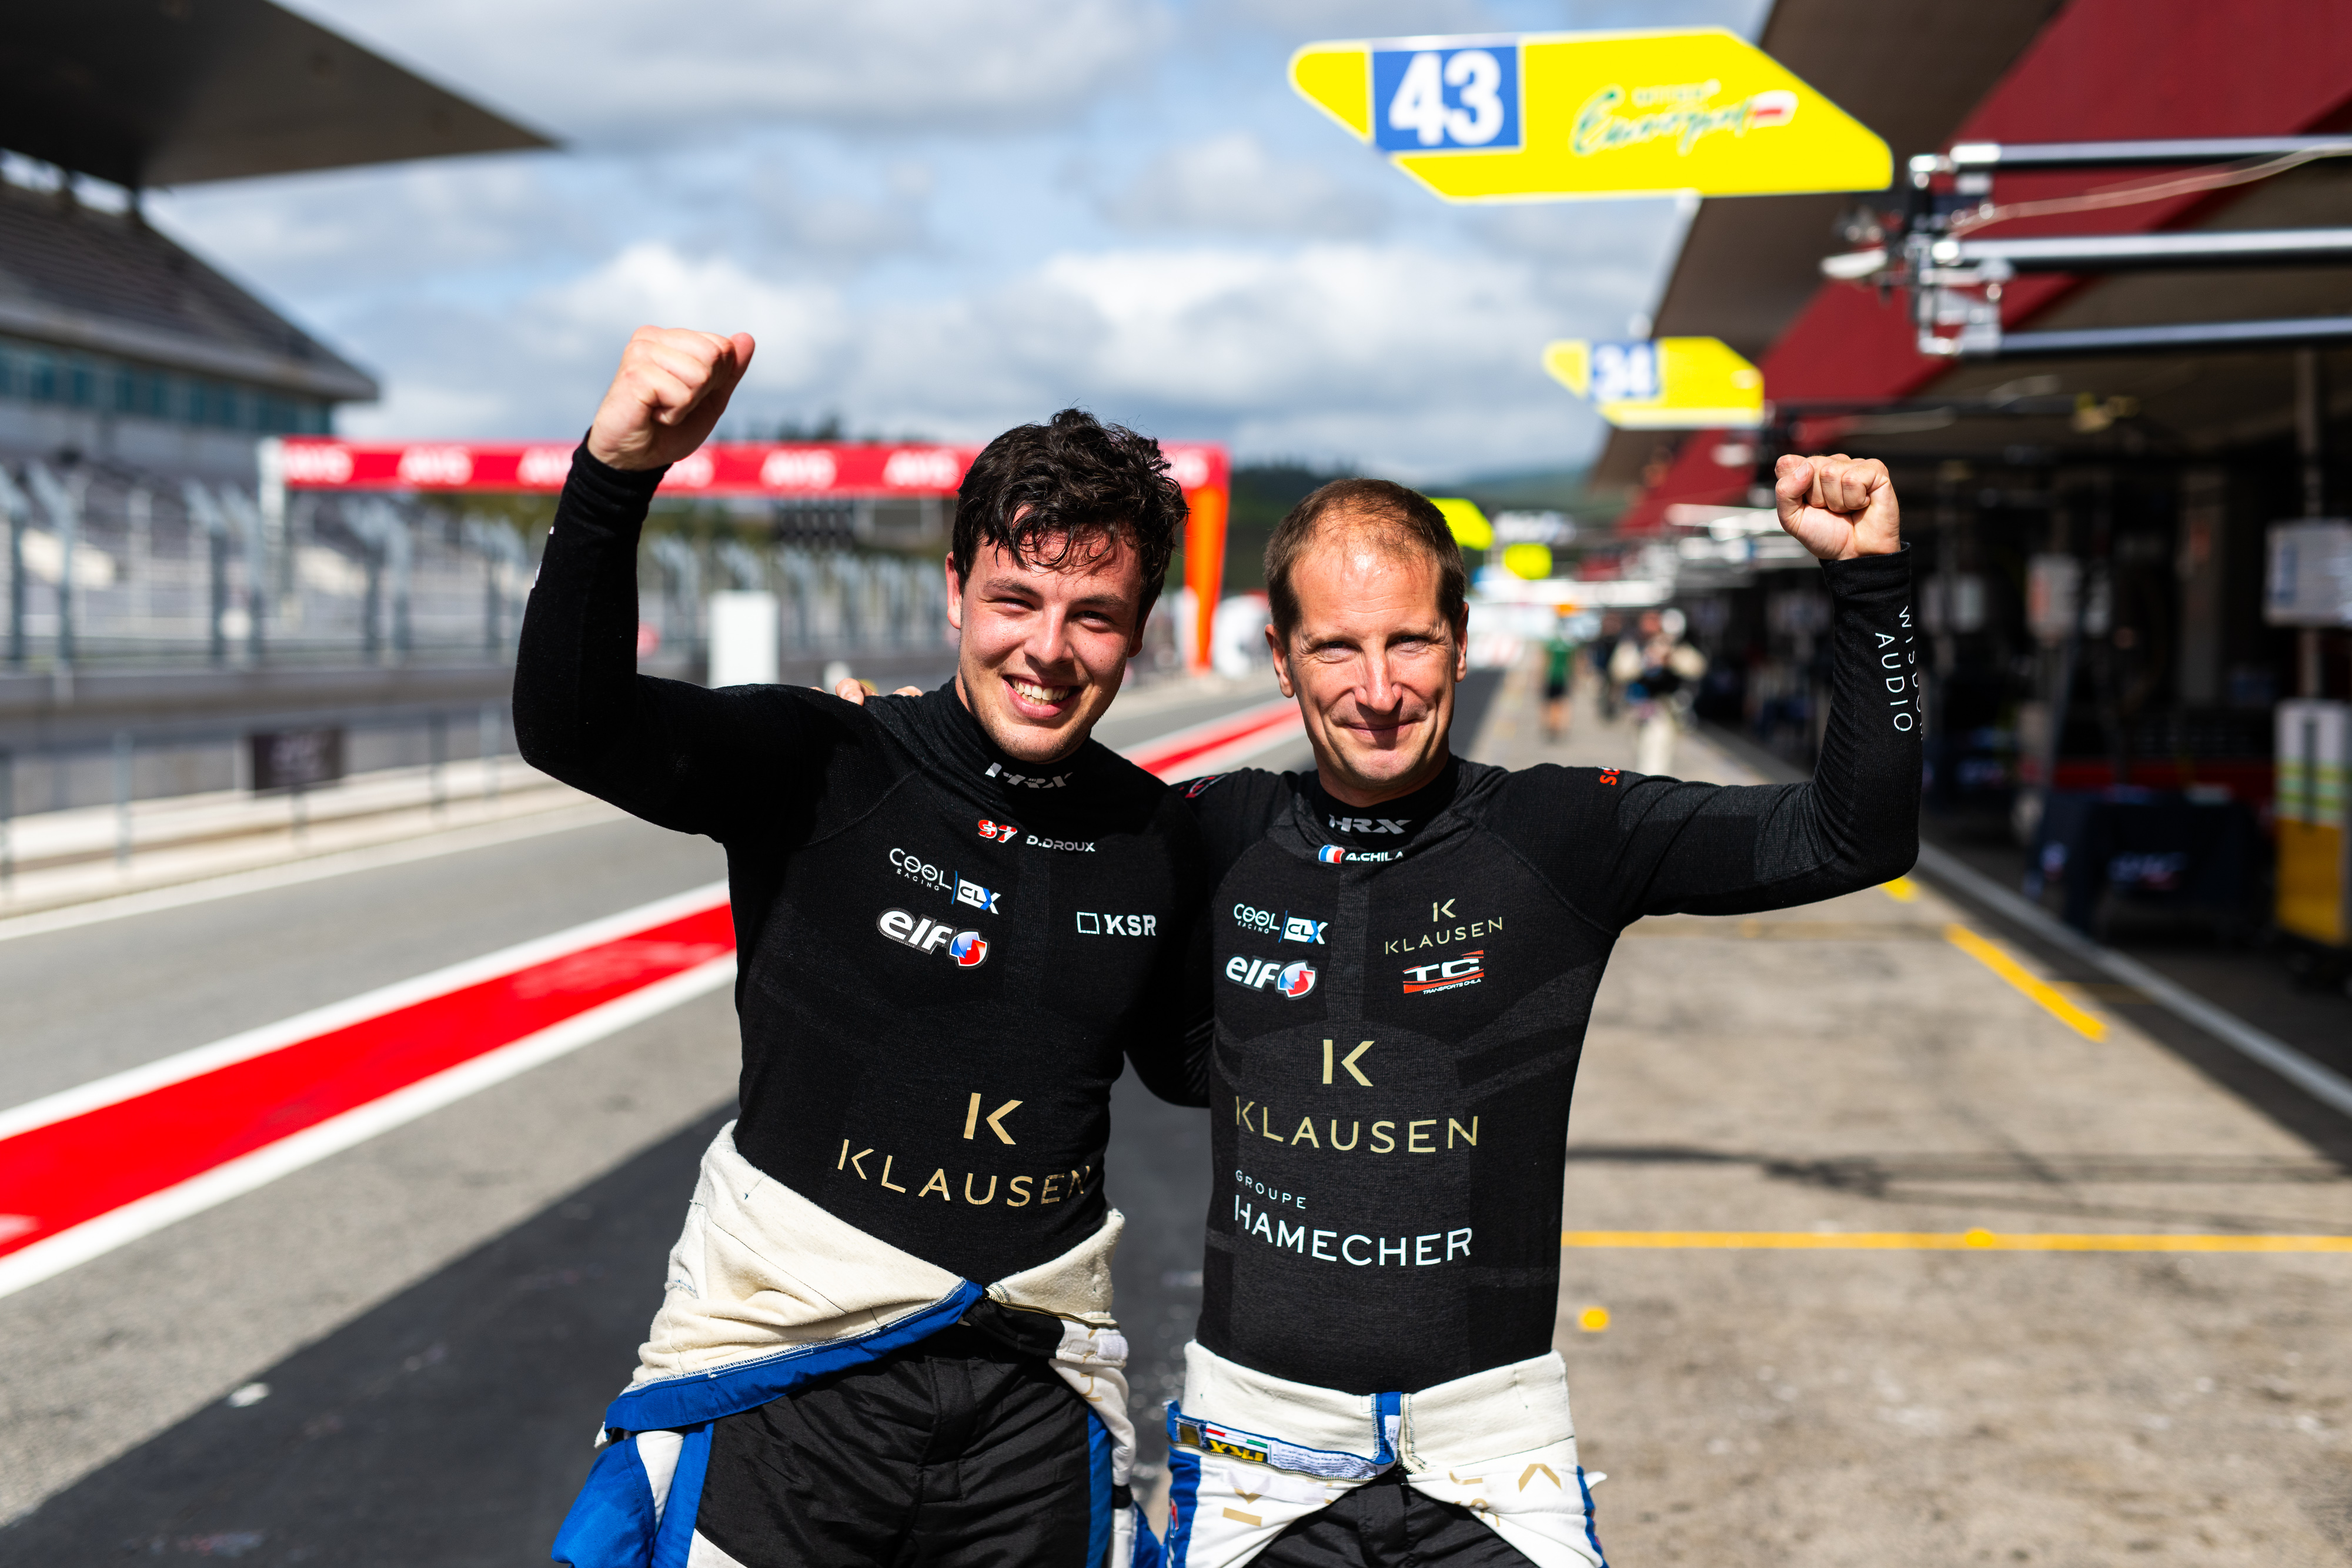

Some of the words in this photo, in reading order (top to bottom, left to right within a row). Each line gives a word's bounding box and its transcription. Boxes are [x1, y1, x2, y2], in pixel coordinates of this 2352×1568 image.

[1388, 48, 1504, 146] 43
[1875, 633, 1913, 731] AUDIO
[978, 820, 1017, 843] 97
[1329, 814, 1412, 834] HRX
[1027, 835, 1095, 852] D.DROUX
[1345, 851, 1404, 862] A.CHILA
[890, 848, 952, 890] COOL
[958, 882, 1001, 914] CLX
[1104, 914, 1156, 936] KSR
[1234, 904, 1280, 930] COOL
[1287, 918, 1328, 944] CLX
[1238, 921, 1269, 934] RACING
[1433, 898, 1456, 922] K
[880, 911, 953, 951] elf
[1385, 917, 1502, 954] KLAUSEN
[1226, 957, 1281, 988] elf
[1404, 958, 1479, 981] TC
[1423, 982, 1463, 994] TRANSPORTS
[1323, 1039, 1374, 1086] K
[964, 1093, 1023, 1145] K
[1236, 1096, 1478, 1153] KLAUSEN
[837, 1139, 1090, 1207] KLAUSEN
[1235, 1170, 1306, 1209] GROUPE
[1235, 1195, 1472, 1266] HAMECHER
